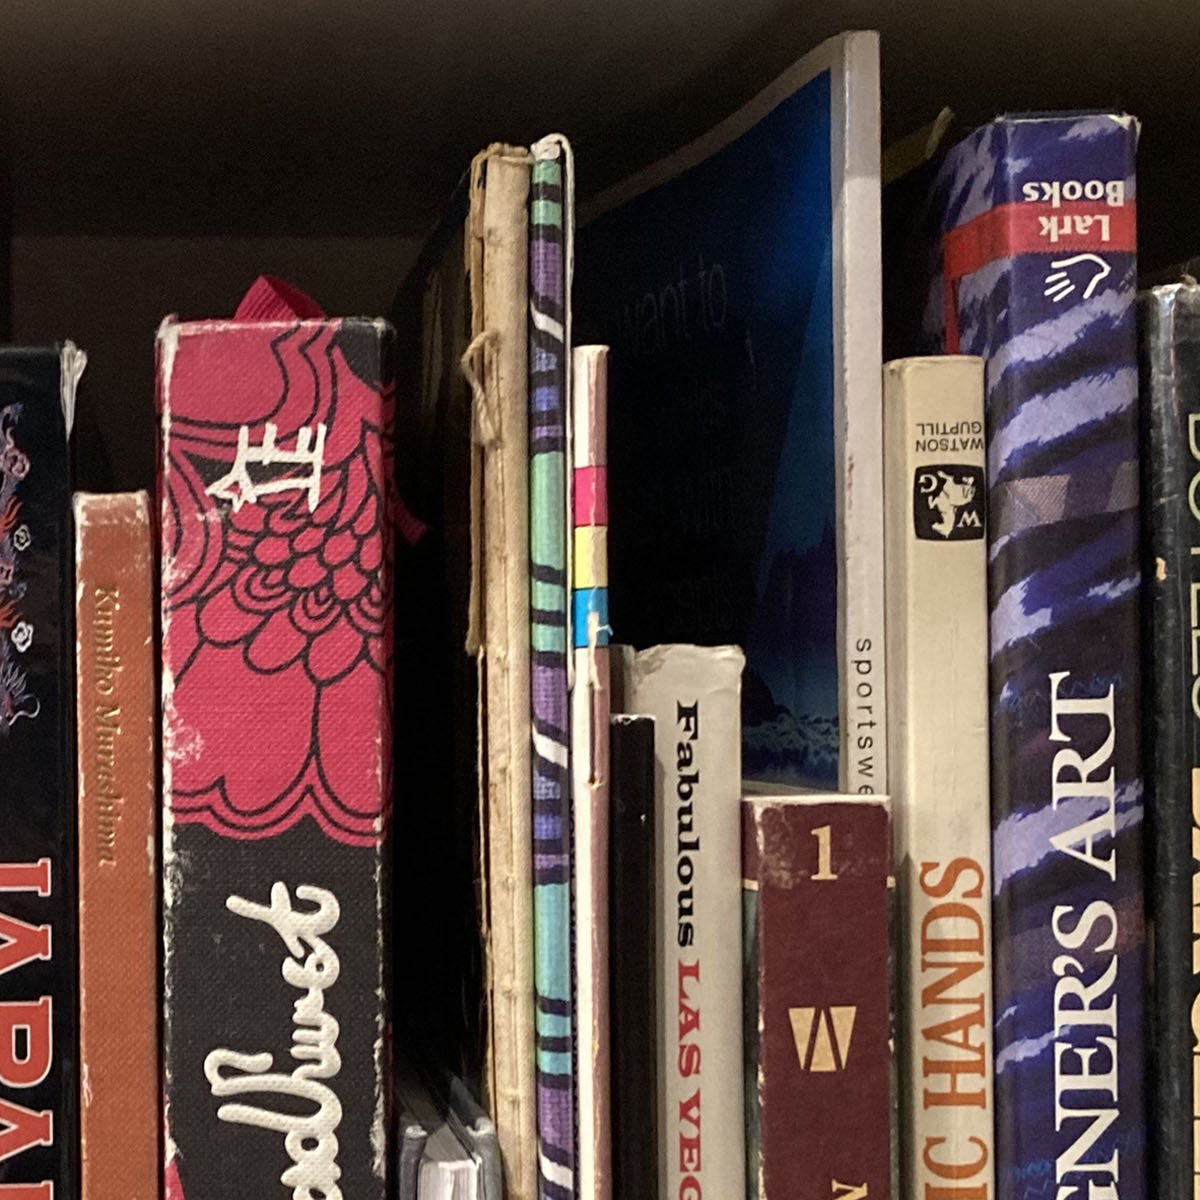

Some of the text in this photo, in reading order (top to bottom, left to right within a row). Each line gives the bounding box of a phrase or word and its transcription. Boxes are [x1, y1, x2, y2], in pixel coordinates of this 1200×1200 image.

[1022, 180, 1125, 207] Books
[1038, 214, 1110, 242] Lark
[915, 421, 983, 436] GUPTILL
[915, 437, 986, 453] WATSON
[957, 510, 982, 528] W
[93, 587, 122, 695] Kumiko
[1048, 671, 1118, 882] ART
[675, 700, 701, 949] Fabulous
[810, 825, 838, 880] 1
[919, 857, 987, 1110] HANDS
[677, 959, 702, 1077] LAS
